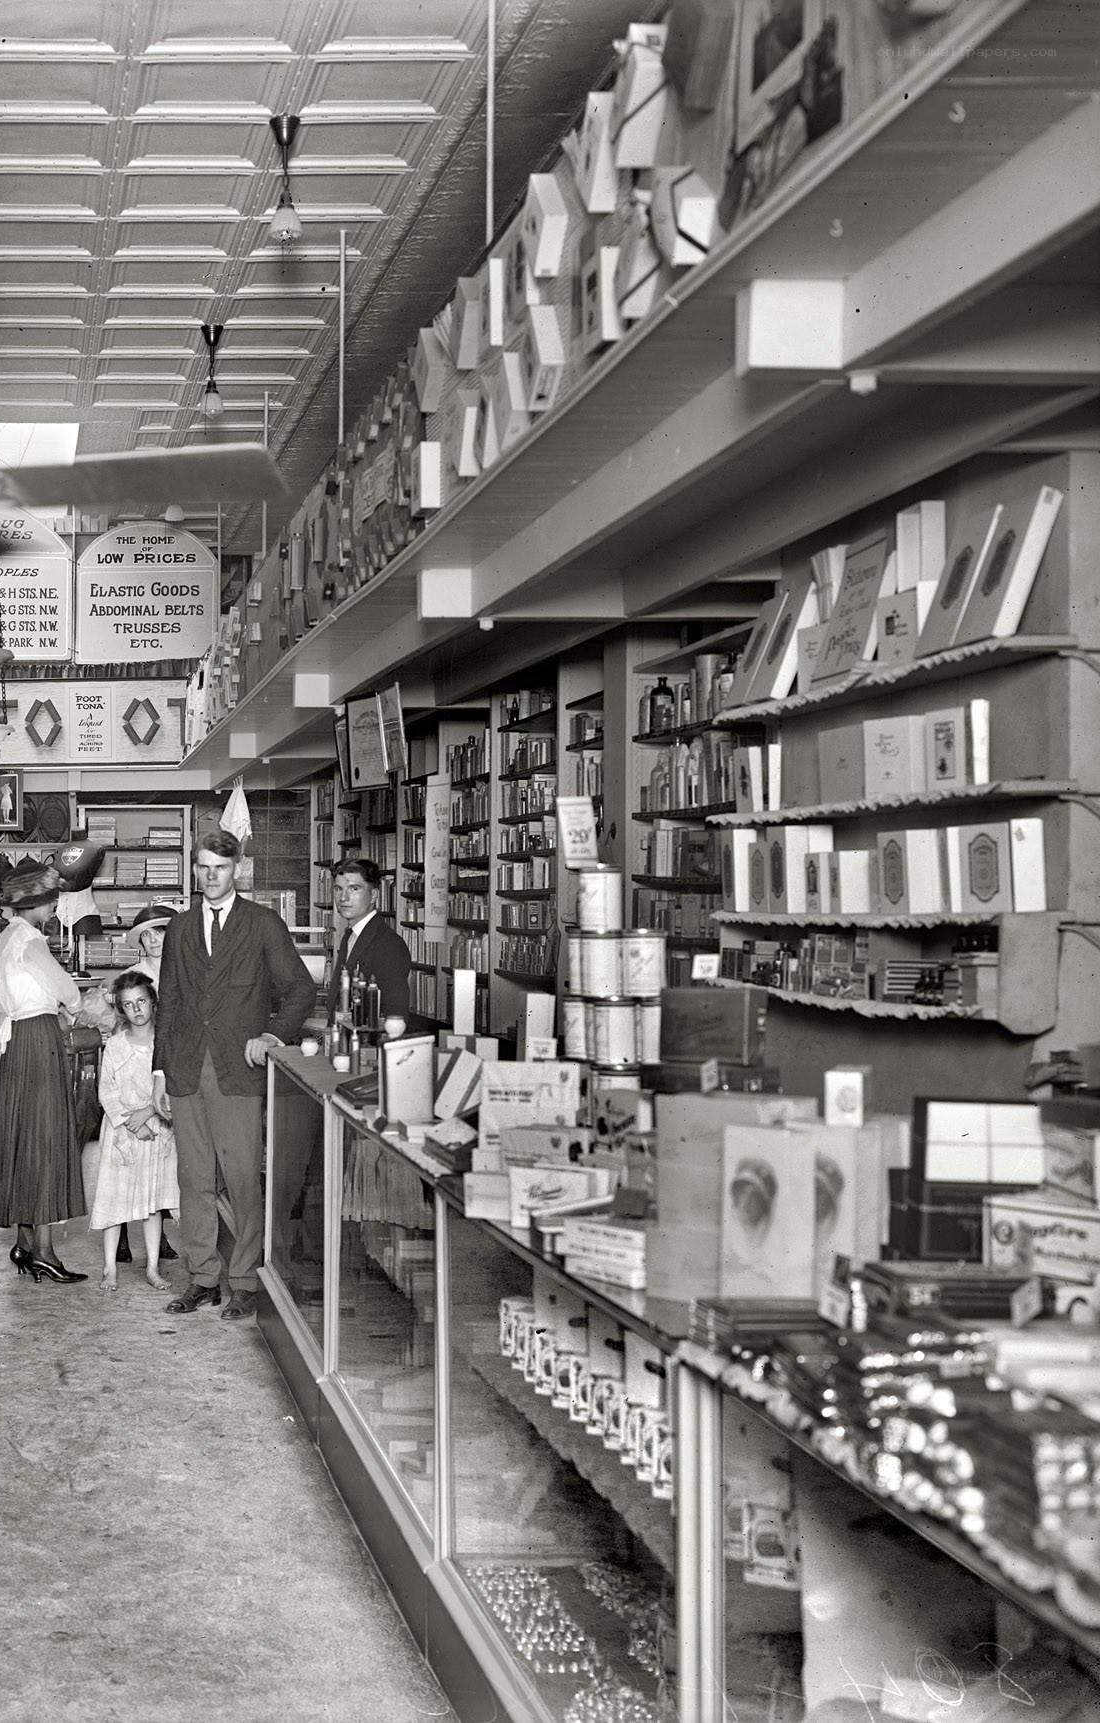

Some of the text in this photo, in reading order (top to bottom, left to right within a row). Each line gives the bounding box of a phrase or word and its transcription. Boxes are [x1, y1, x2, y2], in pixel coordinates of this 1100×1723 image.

[116, 536, 175, 544] THE HOME
[97, 553, 197, 564] LOW PRICES
[18, 588, 38, 598] STS.
[39, 588, 60, 598] N.E.
[90, 582, 200, 598] ELASTIC GOODS
[18, 604, 37, 615] STS.
[39, 604, 59, 615] N.W.
[89, 604, 204, 616] ABDOMINAL BELTS
[18, 620, 38, 632] STS.
[39, 620, 59, 632] N.W.
[113, 622, 182, 634] TRUSSES
[8, 638, 34, 648] PARK
[39, 638, 58, 648] N.W.
[130, 639, 163, 648] ETC.
